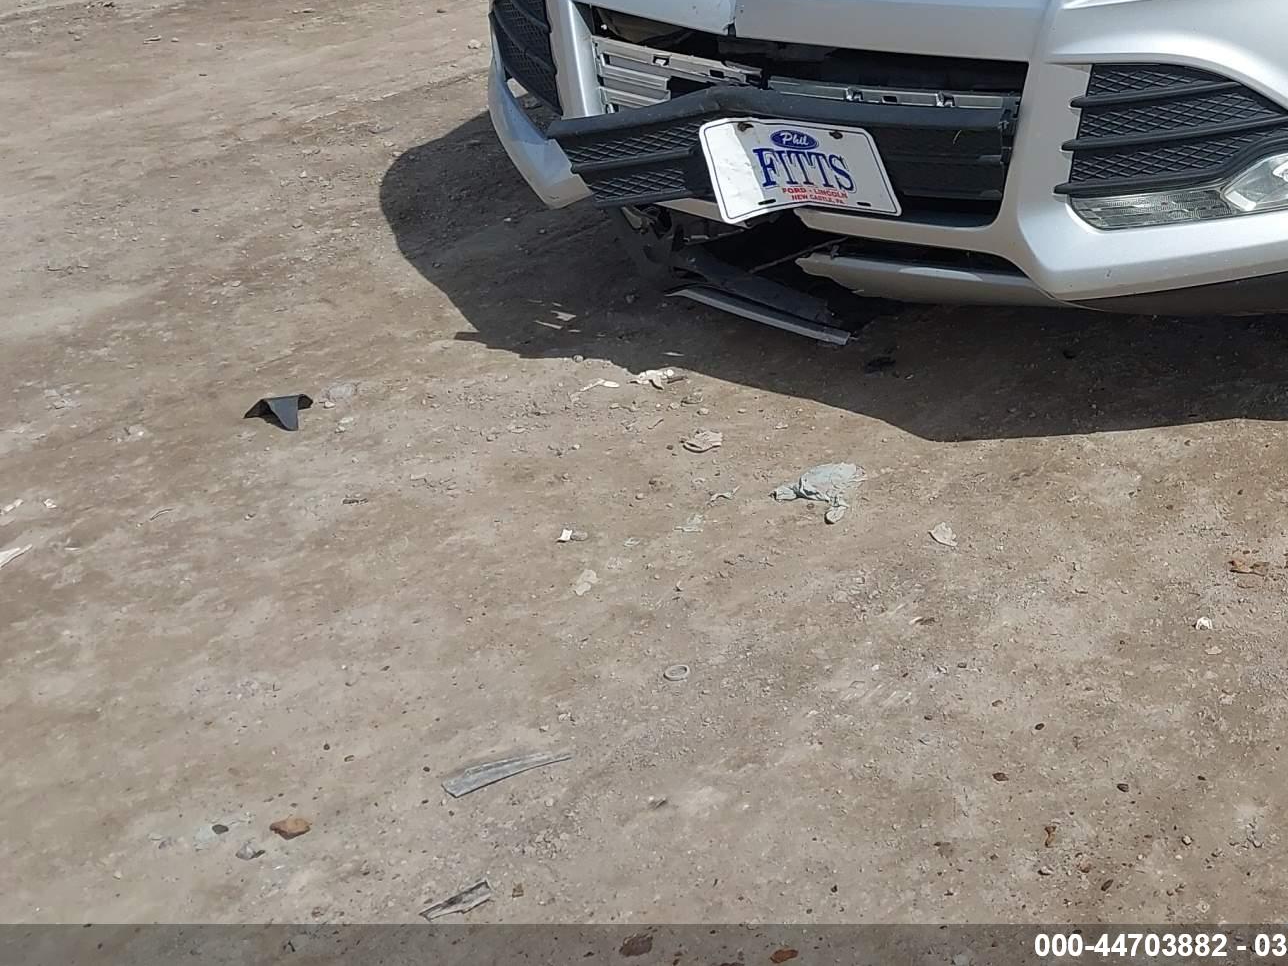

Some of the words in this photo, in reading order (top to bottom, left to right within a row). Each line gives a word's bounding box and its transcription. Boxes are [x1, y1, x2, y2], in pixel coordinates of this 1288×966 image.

[780, 132, 809, 145] Phil
[753, 148, 855, 191] FITTS
[814, 188, 848, 199] LINCOLN
